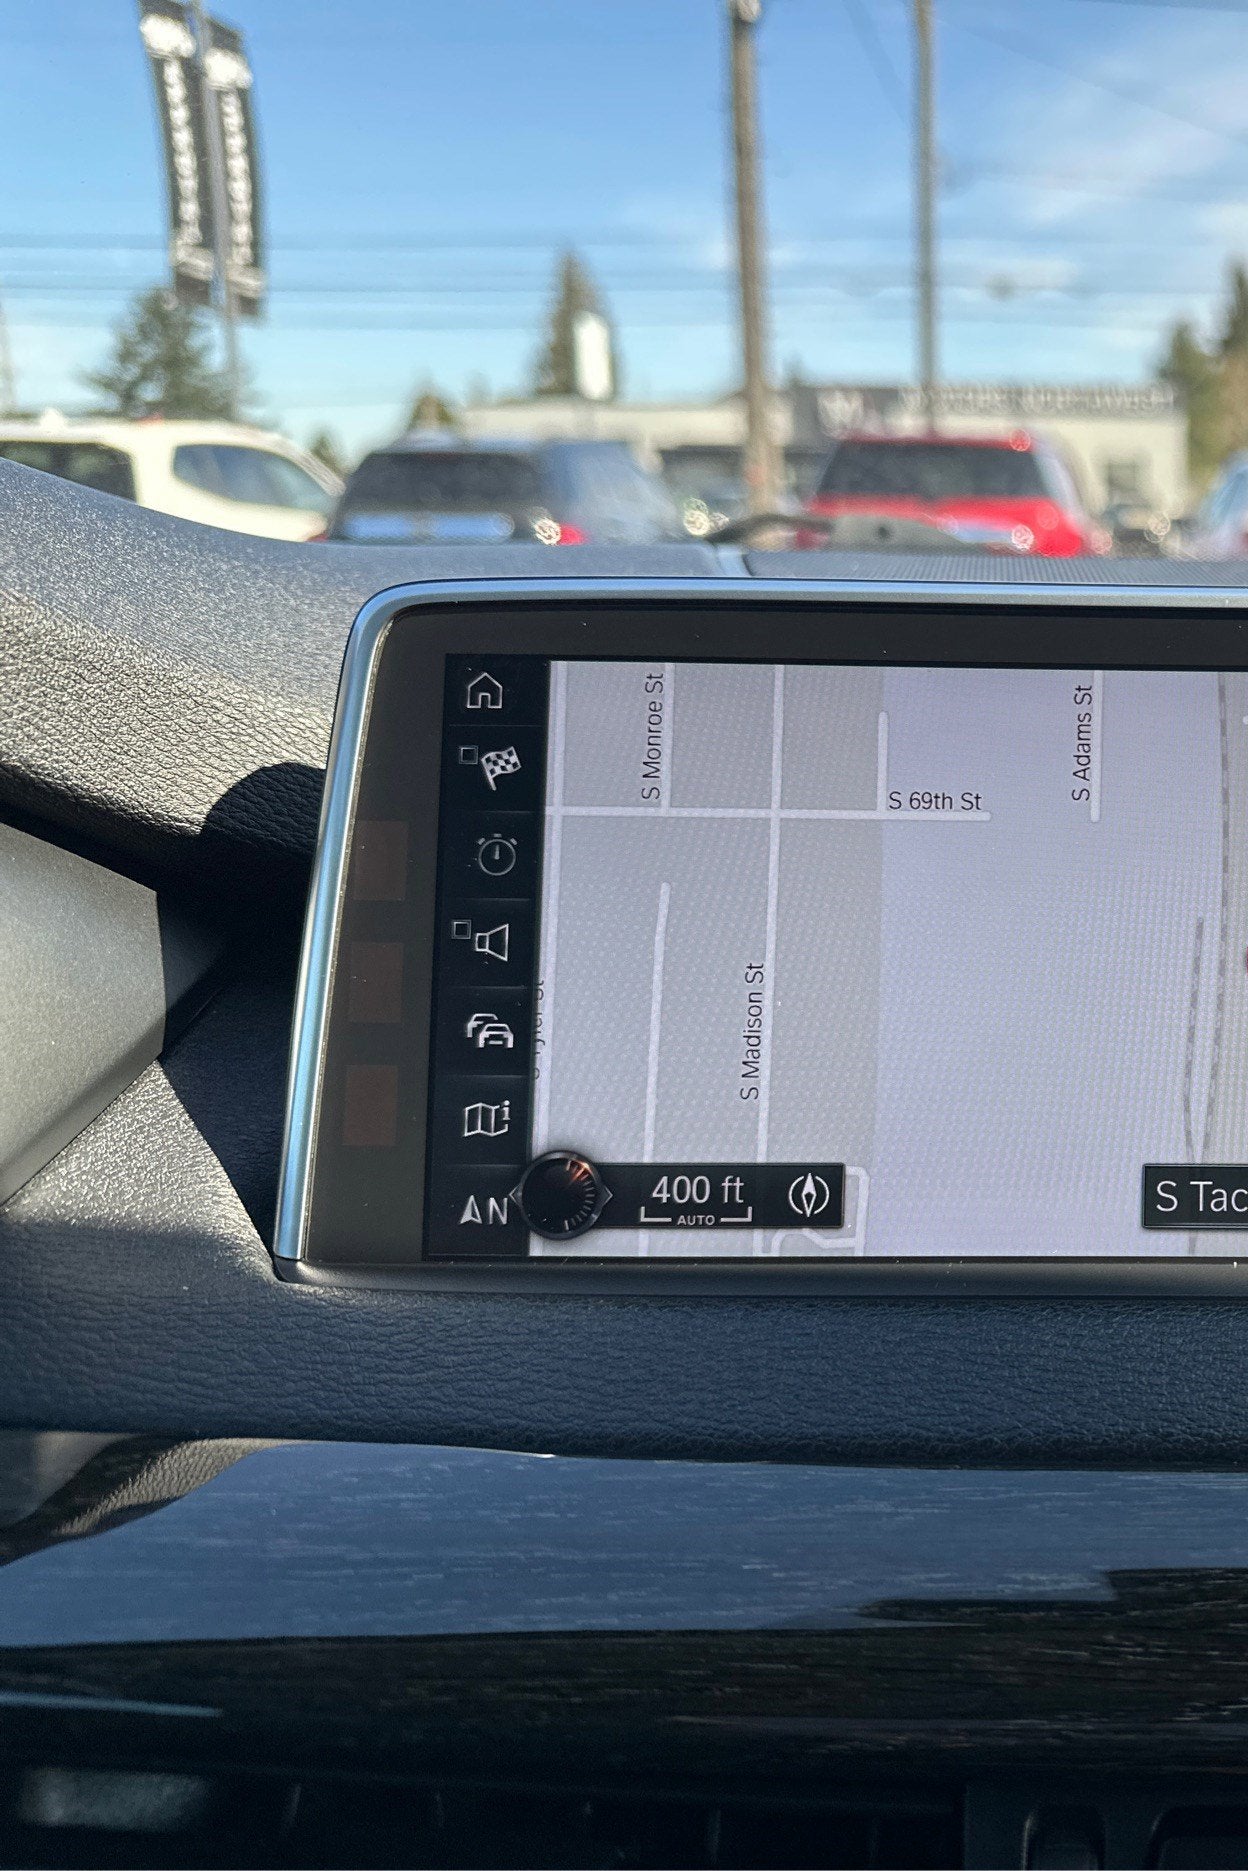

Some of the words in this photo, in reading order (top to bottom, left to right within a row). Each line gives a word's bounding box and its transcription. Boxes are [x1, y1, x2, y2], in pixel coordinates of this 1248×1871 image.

[644, 673, 664, 694] St
[1073, 684, 1093, 706] St
[642, 700, 663, 779] Monroe
[1072, 712, 1092, 782] Adams
[640, 786, 661, 800] S
[888, 790, 903, 810] S
[909, 791, 953, 810] 69th
[960, 791, 982, 811] St
[1071, 788, 1091, 802] S
[744, 962, 764, 984] St
[741, 992, 763, 1079] Madison
[739, 1086, 759, 1100] S
[652, 1175, 711, 1204] 400
[721, 1175, 745, 1204] ft
[1156, 1180, 1178, 1212] S
[488, 1197, 509, 1225] N
[676, 1214, 717, 1227] AUTO
